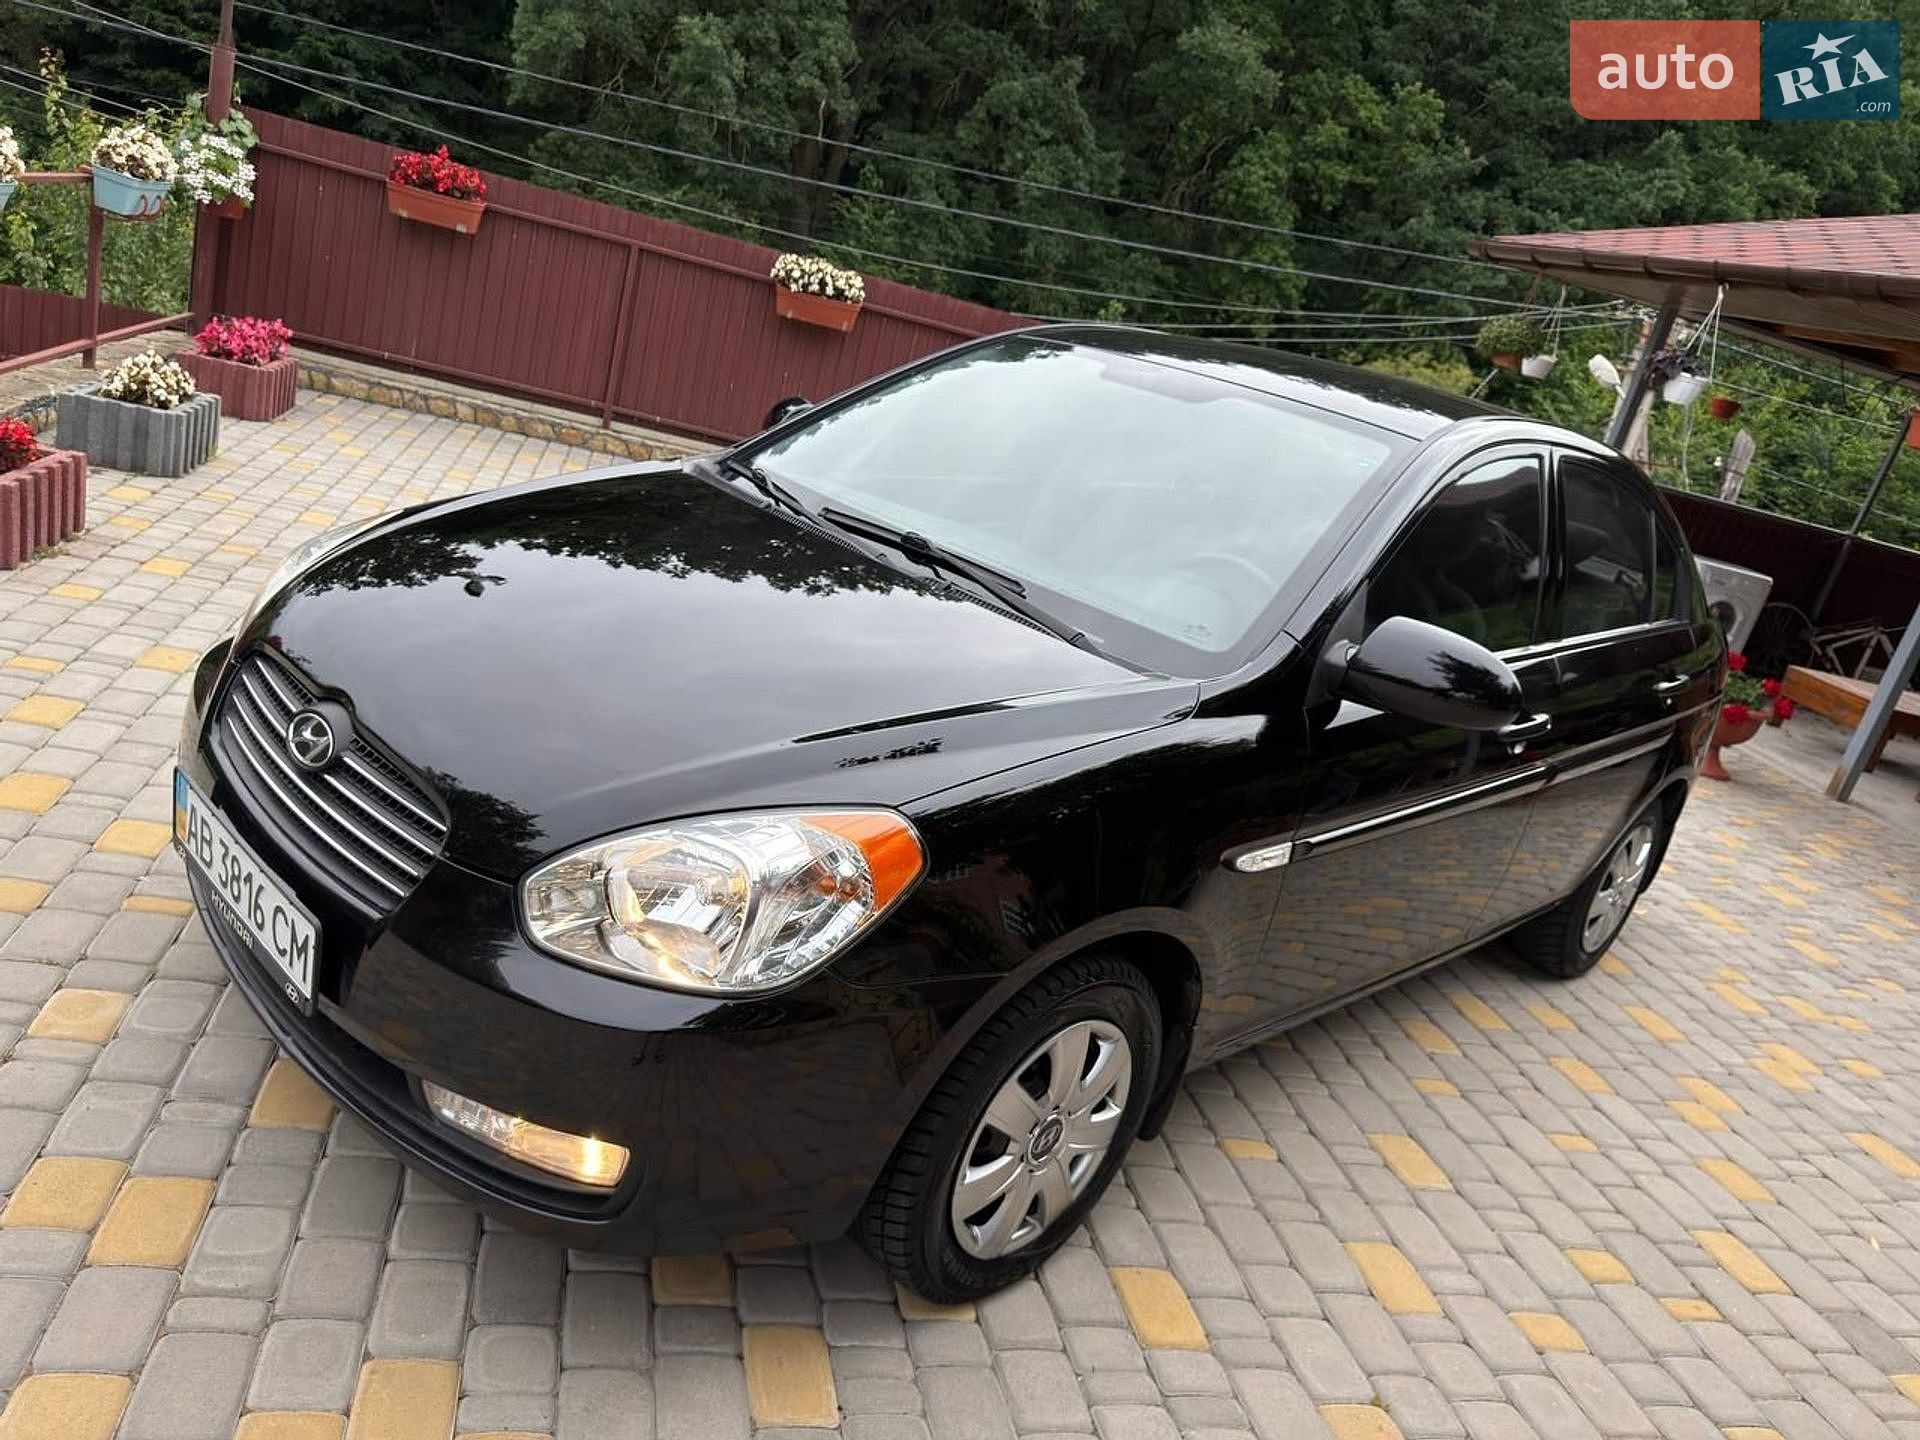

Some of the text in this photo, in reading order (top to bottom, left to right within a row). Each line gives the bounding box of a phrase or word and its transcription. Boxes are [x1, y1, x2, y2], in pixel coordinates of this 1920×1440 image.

[187, 803, 310, 985] AB 3816 CM
